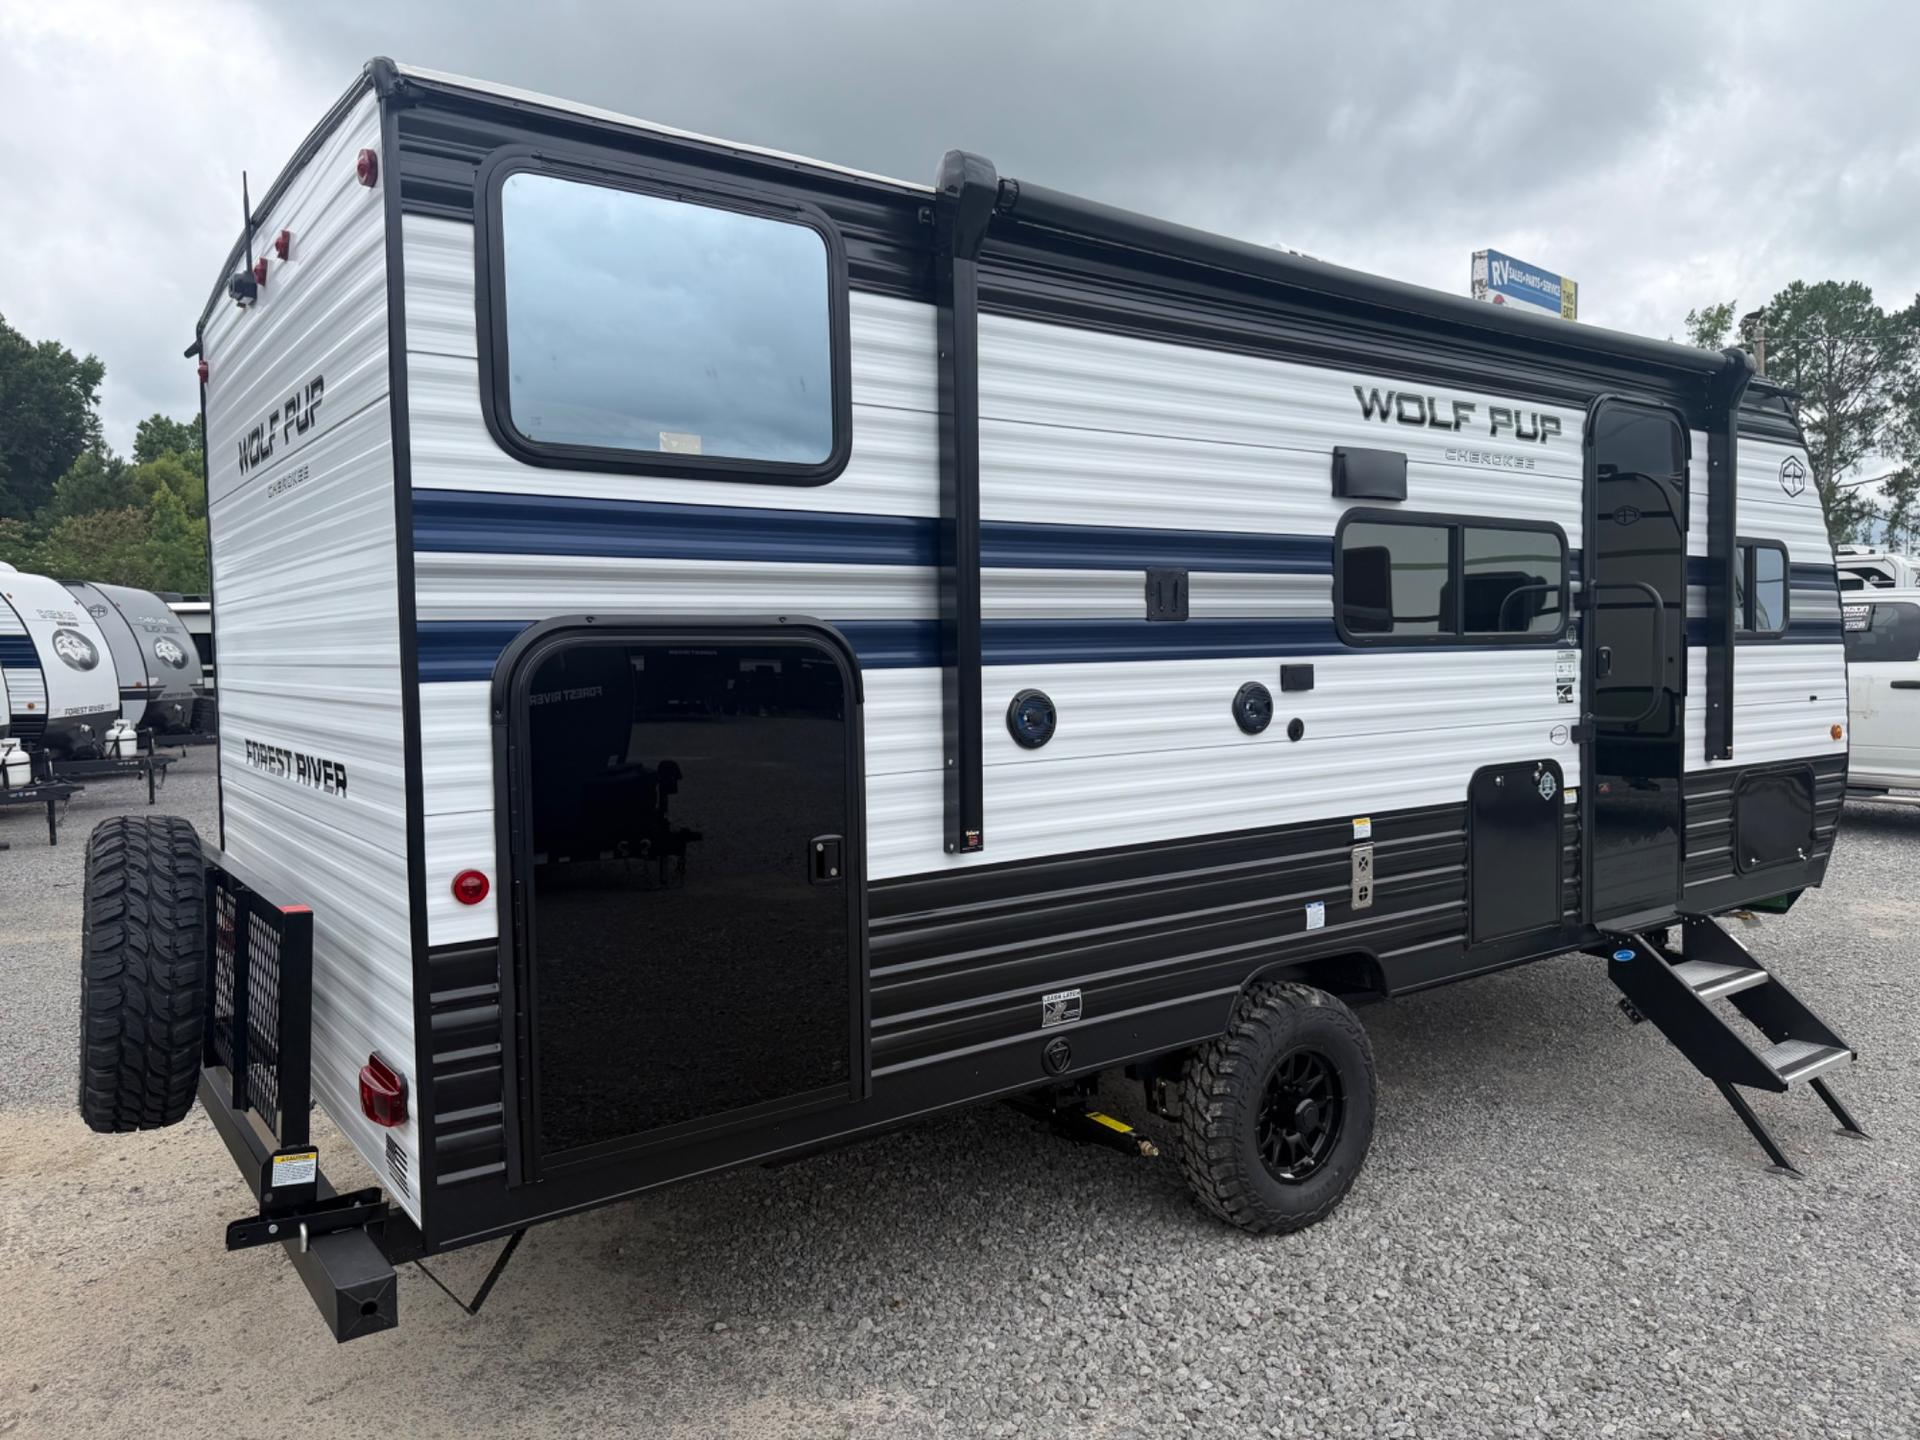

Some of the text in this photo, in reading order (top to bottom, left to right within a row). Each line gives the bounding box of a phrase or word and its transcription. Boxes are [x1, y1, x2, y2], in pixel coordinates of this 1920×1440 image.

[1491, 260, 1509, 286] RV
[238, 374, 324, 476] WOLF PUP
[1353, 385, 1561, 445] WOLF PUP
[1445, 448, 1535, 470] CHEROKEE
[267, 465, 309, 499] CHEROKEE
[64, 706, 88, 716] FOREST
[245, 738, 347, 798] FOREST RIVER
